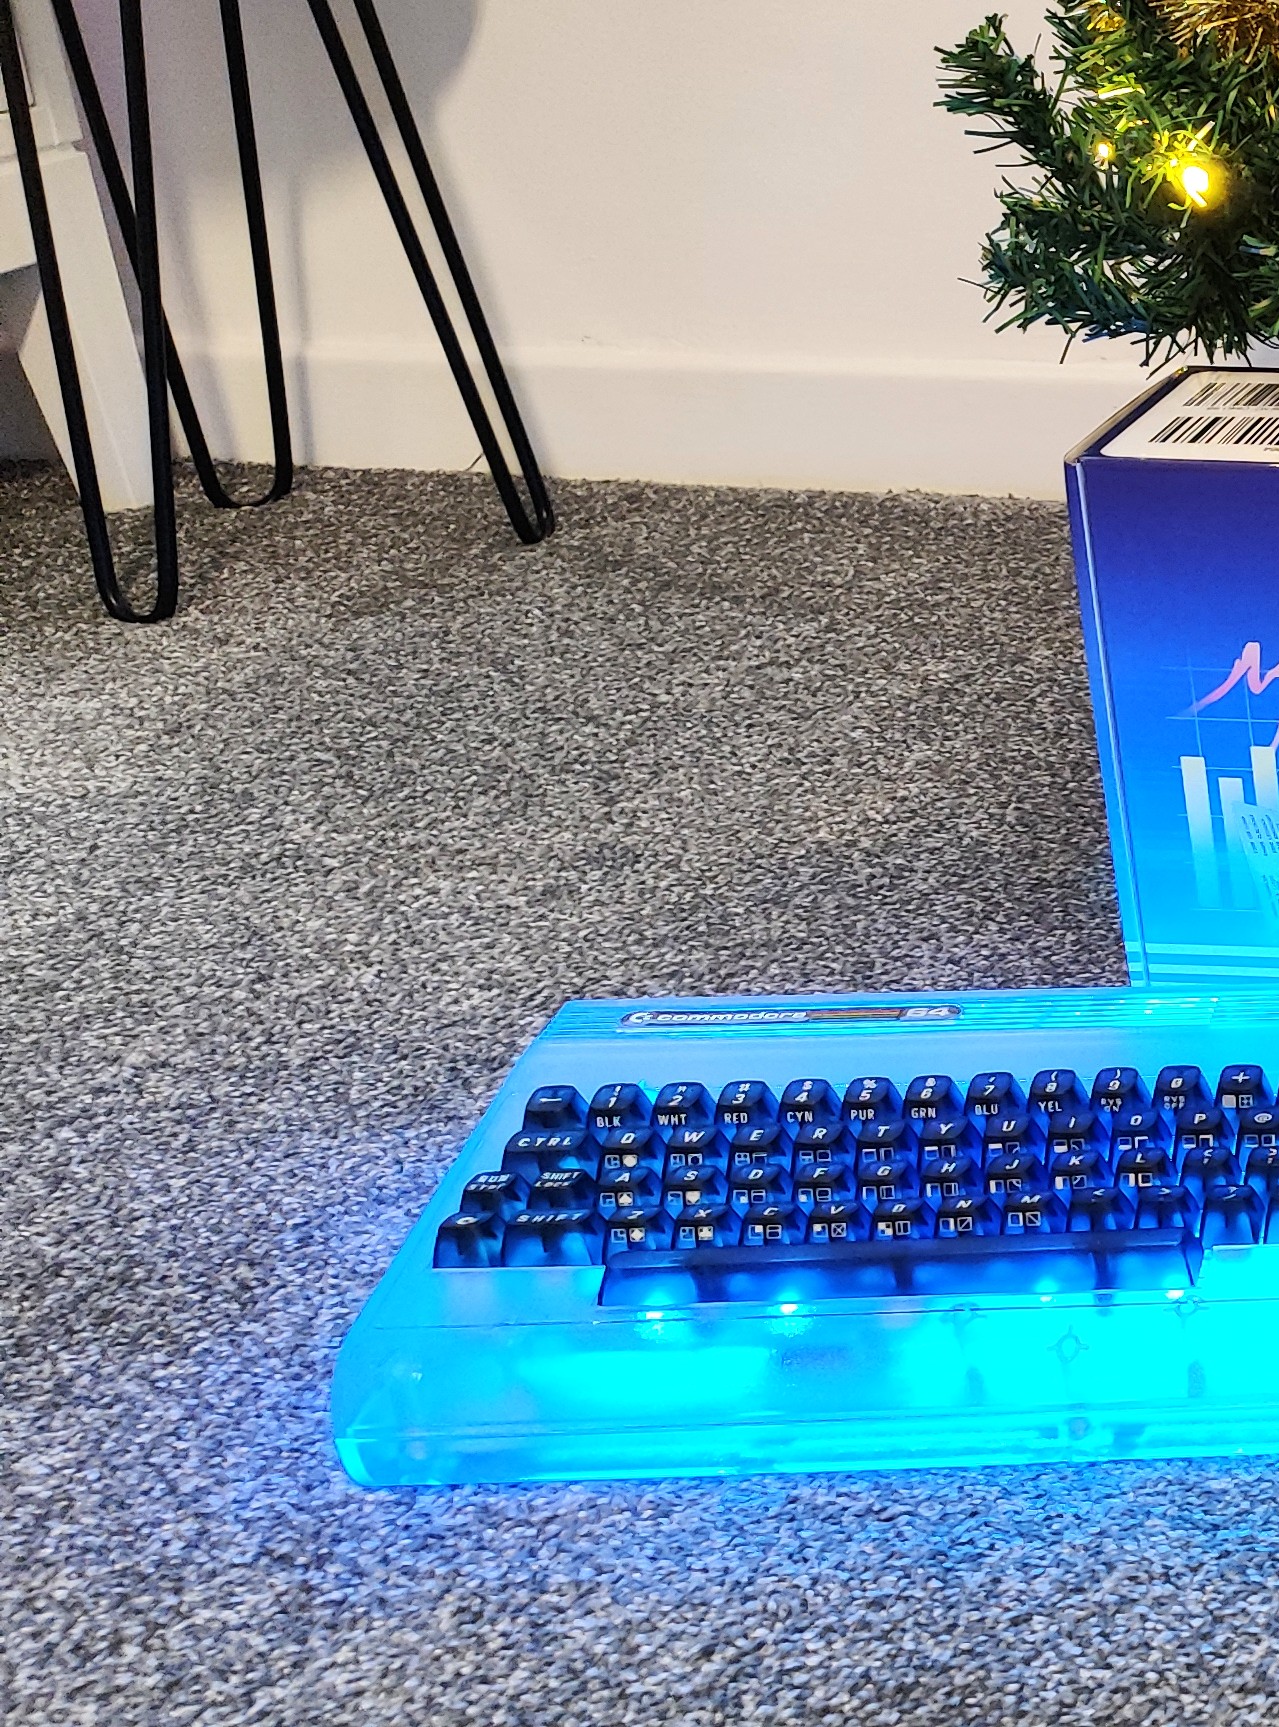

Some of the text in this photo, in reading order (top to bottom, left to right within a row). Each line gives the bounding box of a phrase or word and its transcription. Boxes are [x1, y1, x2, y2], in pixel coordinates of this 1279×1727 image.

[655, 1007, 950, 1023] commodore 64
[911, 1107, 937, 1119] GRN
[975, 1104, 999, 1116] BLU
[1038, 1101, 1063, 1113] YEL
[657, 1114, 688, 1126] WHT
[724, 1112, 748, 1125] RED
[787, 1111, 813, 1123] CYN
[850, 1109, 875, 1121] PUR
[596, 1116, 621, 1128] BLK
[516, 1136, 573, 1148] CTRL
[541, 1171, 582, 1181] SHIFT
[515, 1212, 583, 1224] SHIFT
